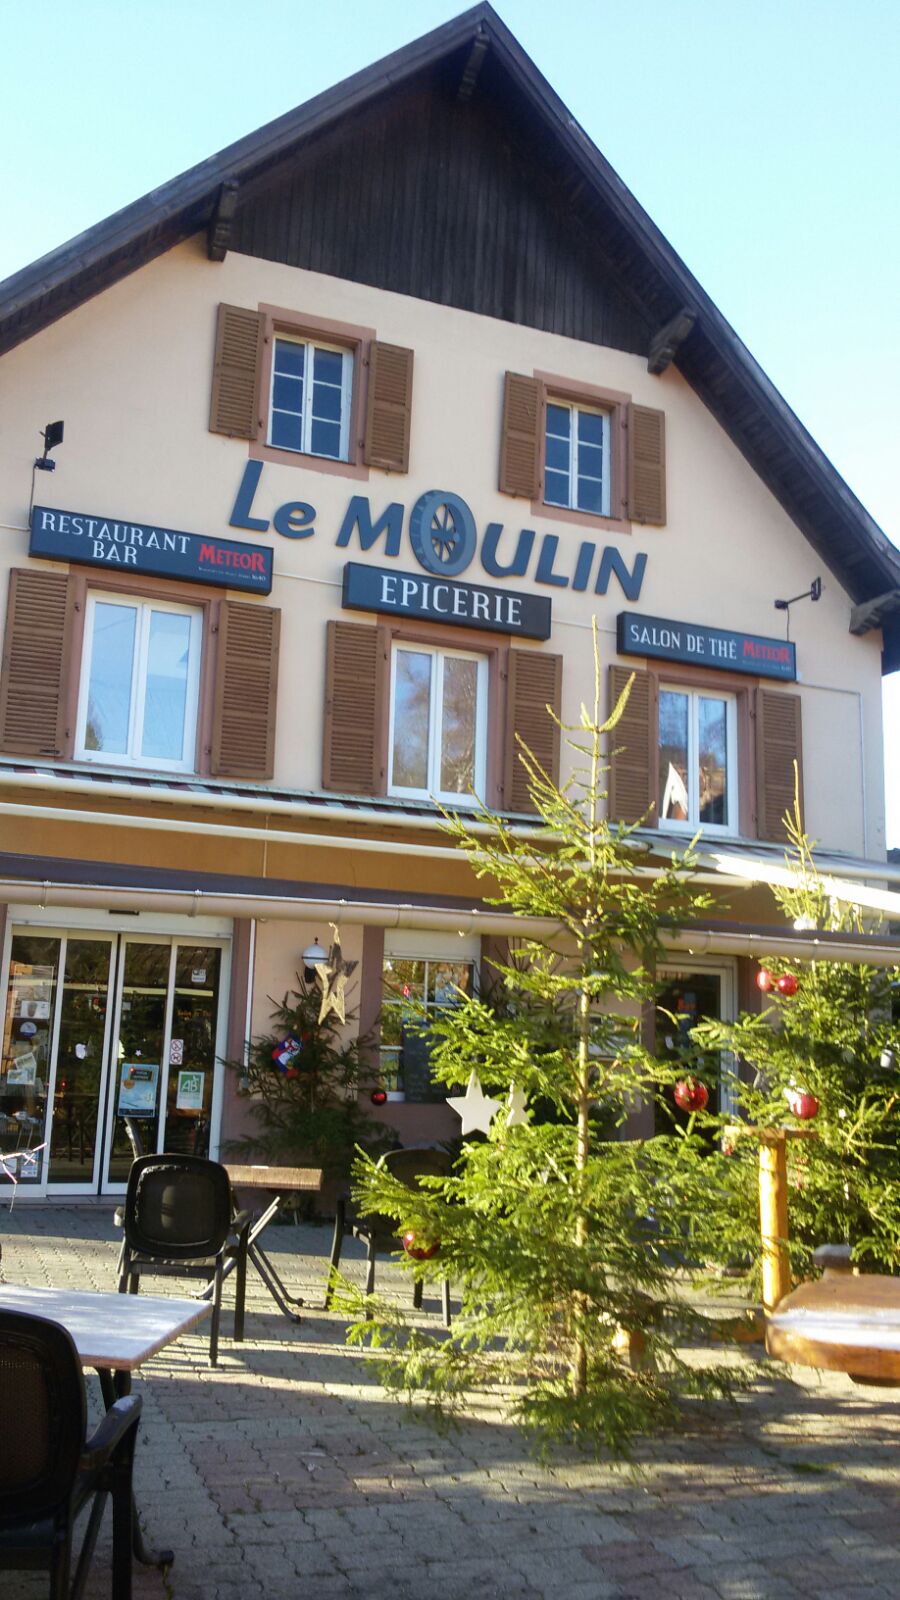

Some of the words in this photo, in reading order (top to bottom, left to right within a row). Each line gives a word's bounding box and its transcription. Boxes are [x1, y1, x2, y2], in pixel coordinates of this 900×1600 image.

[41, 511, 190, 554] RESTAURANT
[230, 460, 317, 539] Le
[335, 489, 648, 601] MOULIN
[92, 540, 138, 565] BAR
[198, 543, 266, 574] METEOR
[380, 575, 522, 626] EPICERIE
[630, 624, 681, 649] SALON
[687, 634, 705, 654] DE
[708, 639, 737, 660] THÉ
[742, 640, 791, 663] METEOR
